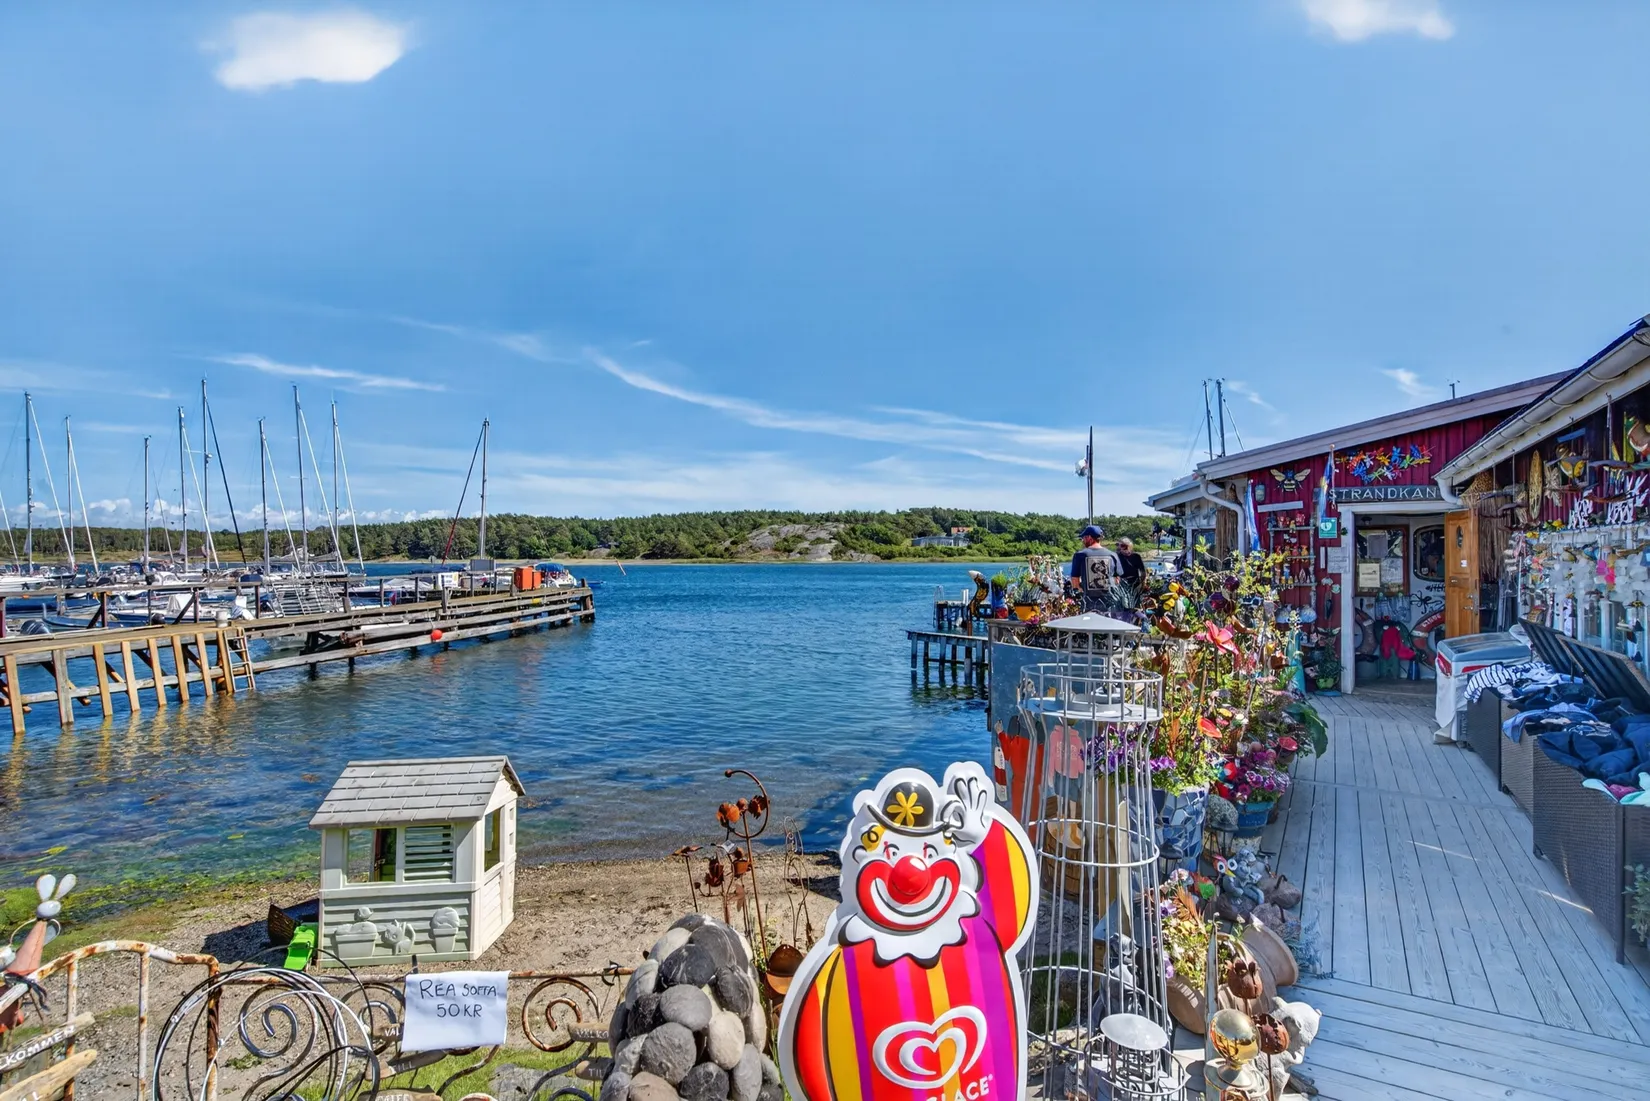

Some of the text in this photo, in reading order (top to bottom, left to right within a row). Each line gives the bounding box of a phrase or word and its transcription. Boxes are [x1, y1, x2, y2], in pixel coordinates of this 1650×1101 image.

[419, 979, 497, 999] REA SOFFA
[436, 1003, 483, 1018] 50 KR
